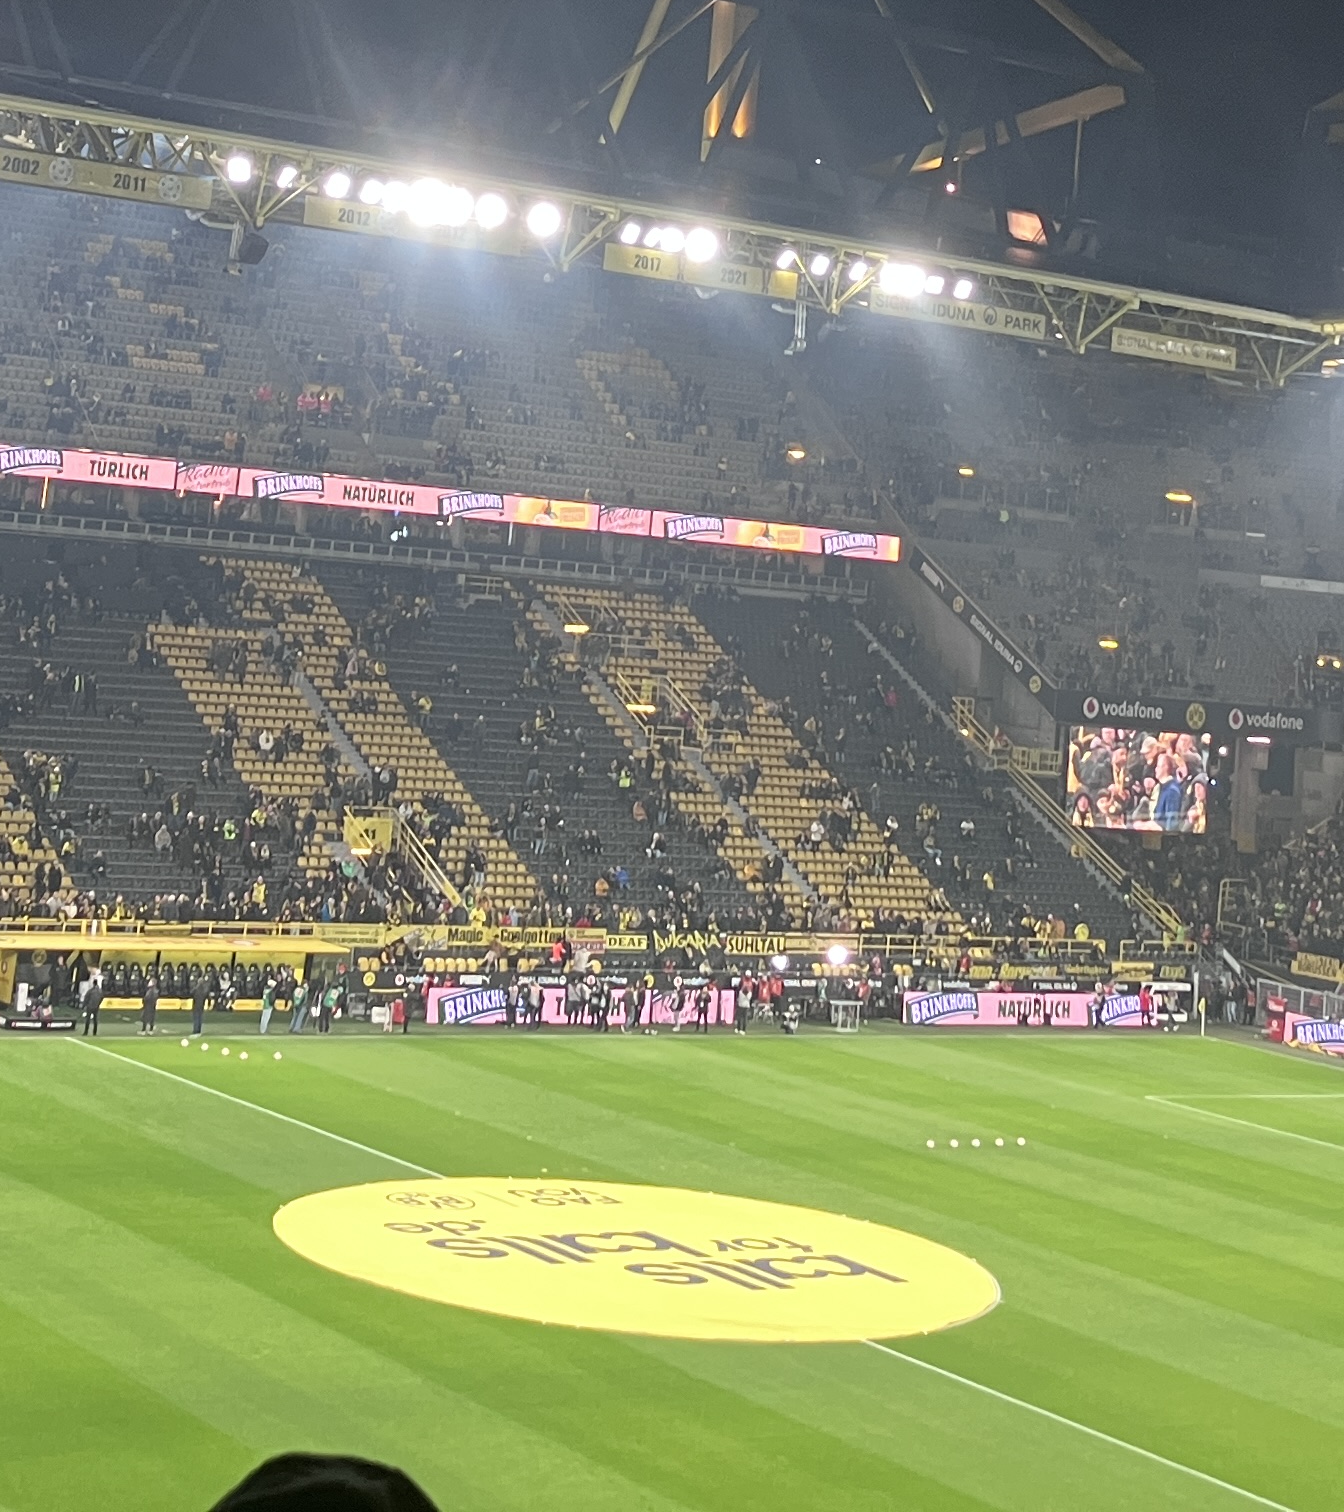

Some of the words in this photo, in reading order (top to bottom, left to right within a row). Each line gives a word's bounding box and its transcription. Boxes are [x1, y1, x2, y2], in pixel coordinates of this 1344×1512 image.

[2, 155, 40, 176] 2002
[113, 173, 146, 192] 2011
[337, 207, 370, 227] 2012
[633, 252, 662, 273] 2017
[719, 266, 748, 287] 2021
[932, 304, 975, 322] IDUNA
[1004, 314, 1042, 334] PARK
[89, 457, 149, 481] TÜRLICH
[342, 484, 416, 508] NATÜRLICH
[1102, 700, 1164, 721] vodafone
[1246, 712, 1304, 731] vodafone
[447, 928, 484, 944] Magic
[608, 937, 646, 948] DEAF
[709, 1237, 815, 1254] for
